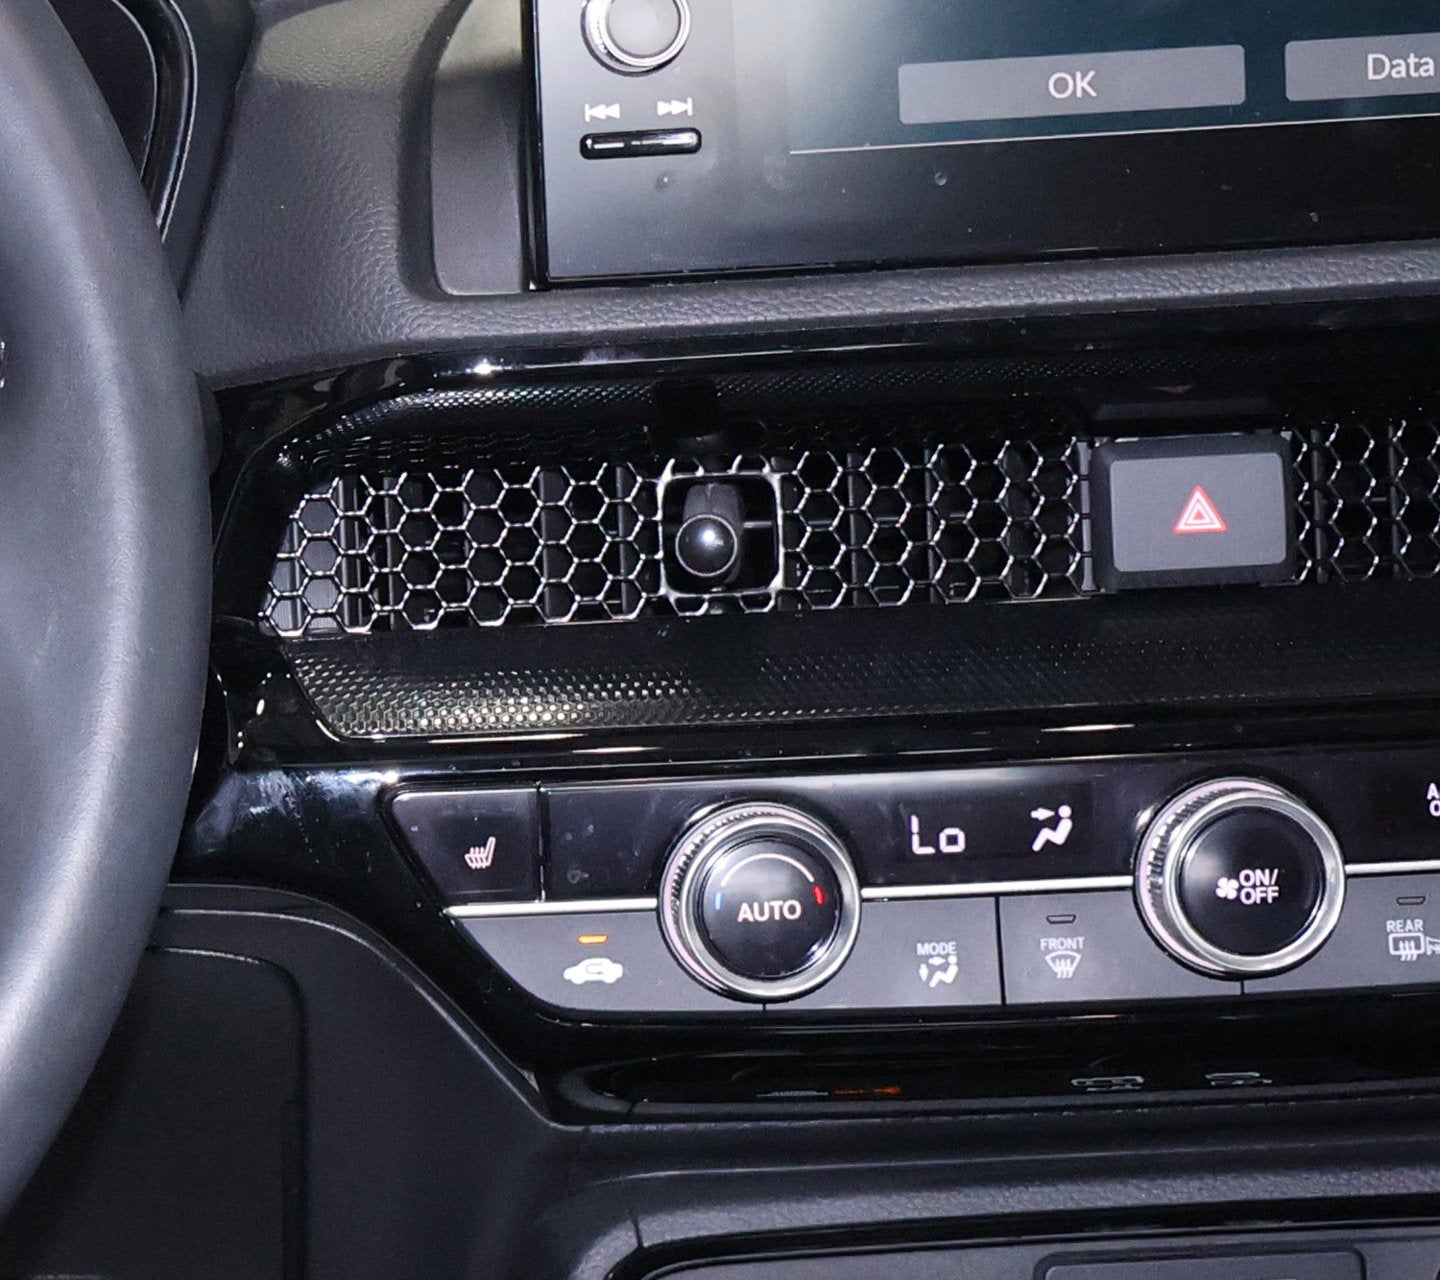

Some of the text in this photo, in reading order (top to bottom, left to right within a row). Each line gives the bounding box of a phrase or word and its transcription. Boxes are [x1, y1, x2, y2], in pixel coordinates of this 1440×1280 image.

[1368, 53, 1434, 80] Data
[1049, 71, 1097, 98] OK
[1239, 886, 1281, 906] OFF
[737, 897, 803, 924] AUTO
[1385, 918, 1425, 933] REAR
[916, 941, 958, 958] MODE
[1039, 936, 1086, 952] FRONT
